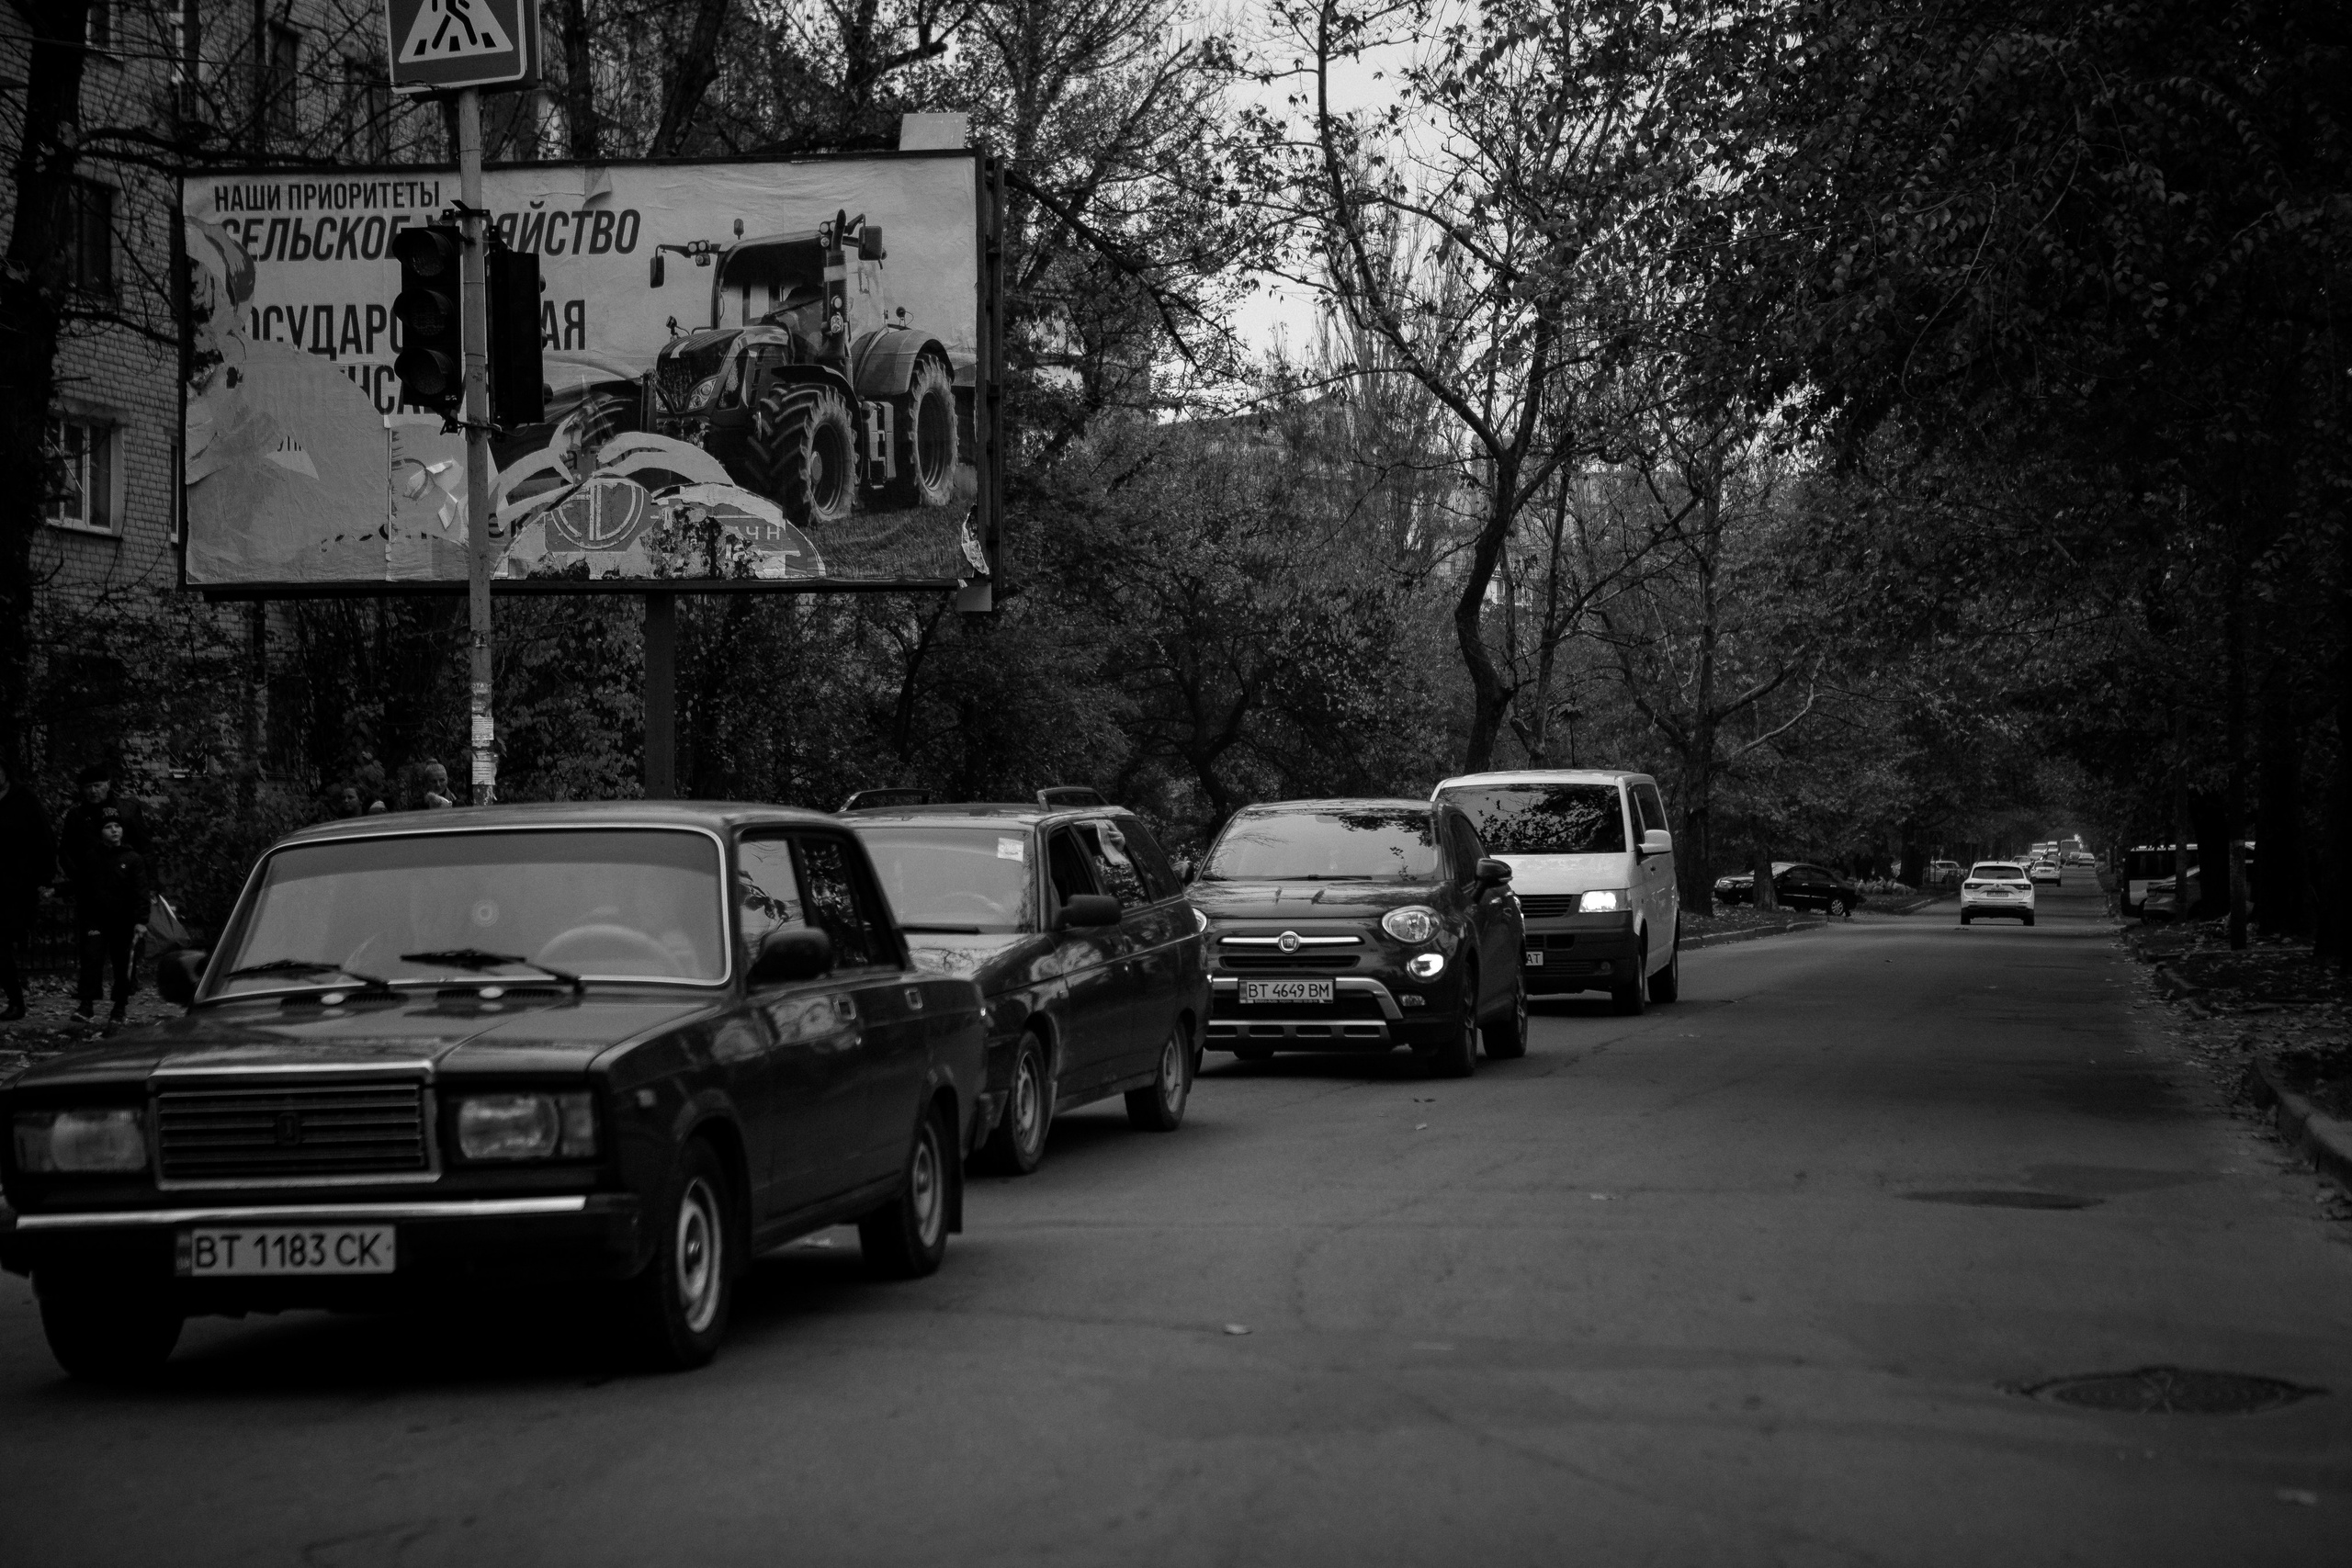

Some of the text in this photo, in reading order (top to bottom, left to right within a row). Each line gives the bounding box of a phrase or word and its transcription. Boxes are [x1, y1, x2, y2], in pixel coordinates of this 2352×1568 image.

[214, 181, 440, 212] НАШИ ПРИОРИТЕТЫ
[1249, 983, 1329, 998] BT 4649 BM
[196, 1232, 382, 1269] BT 1183 CK
